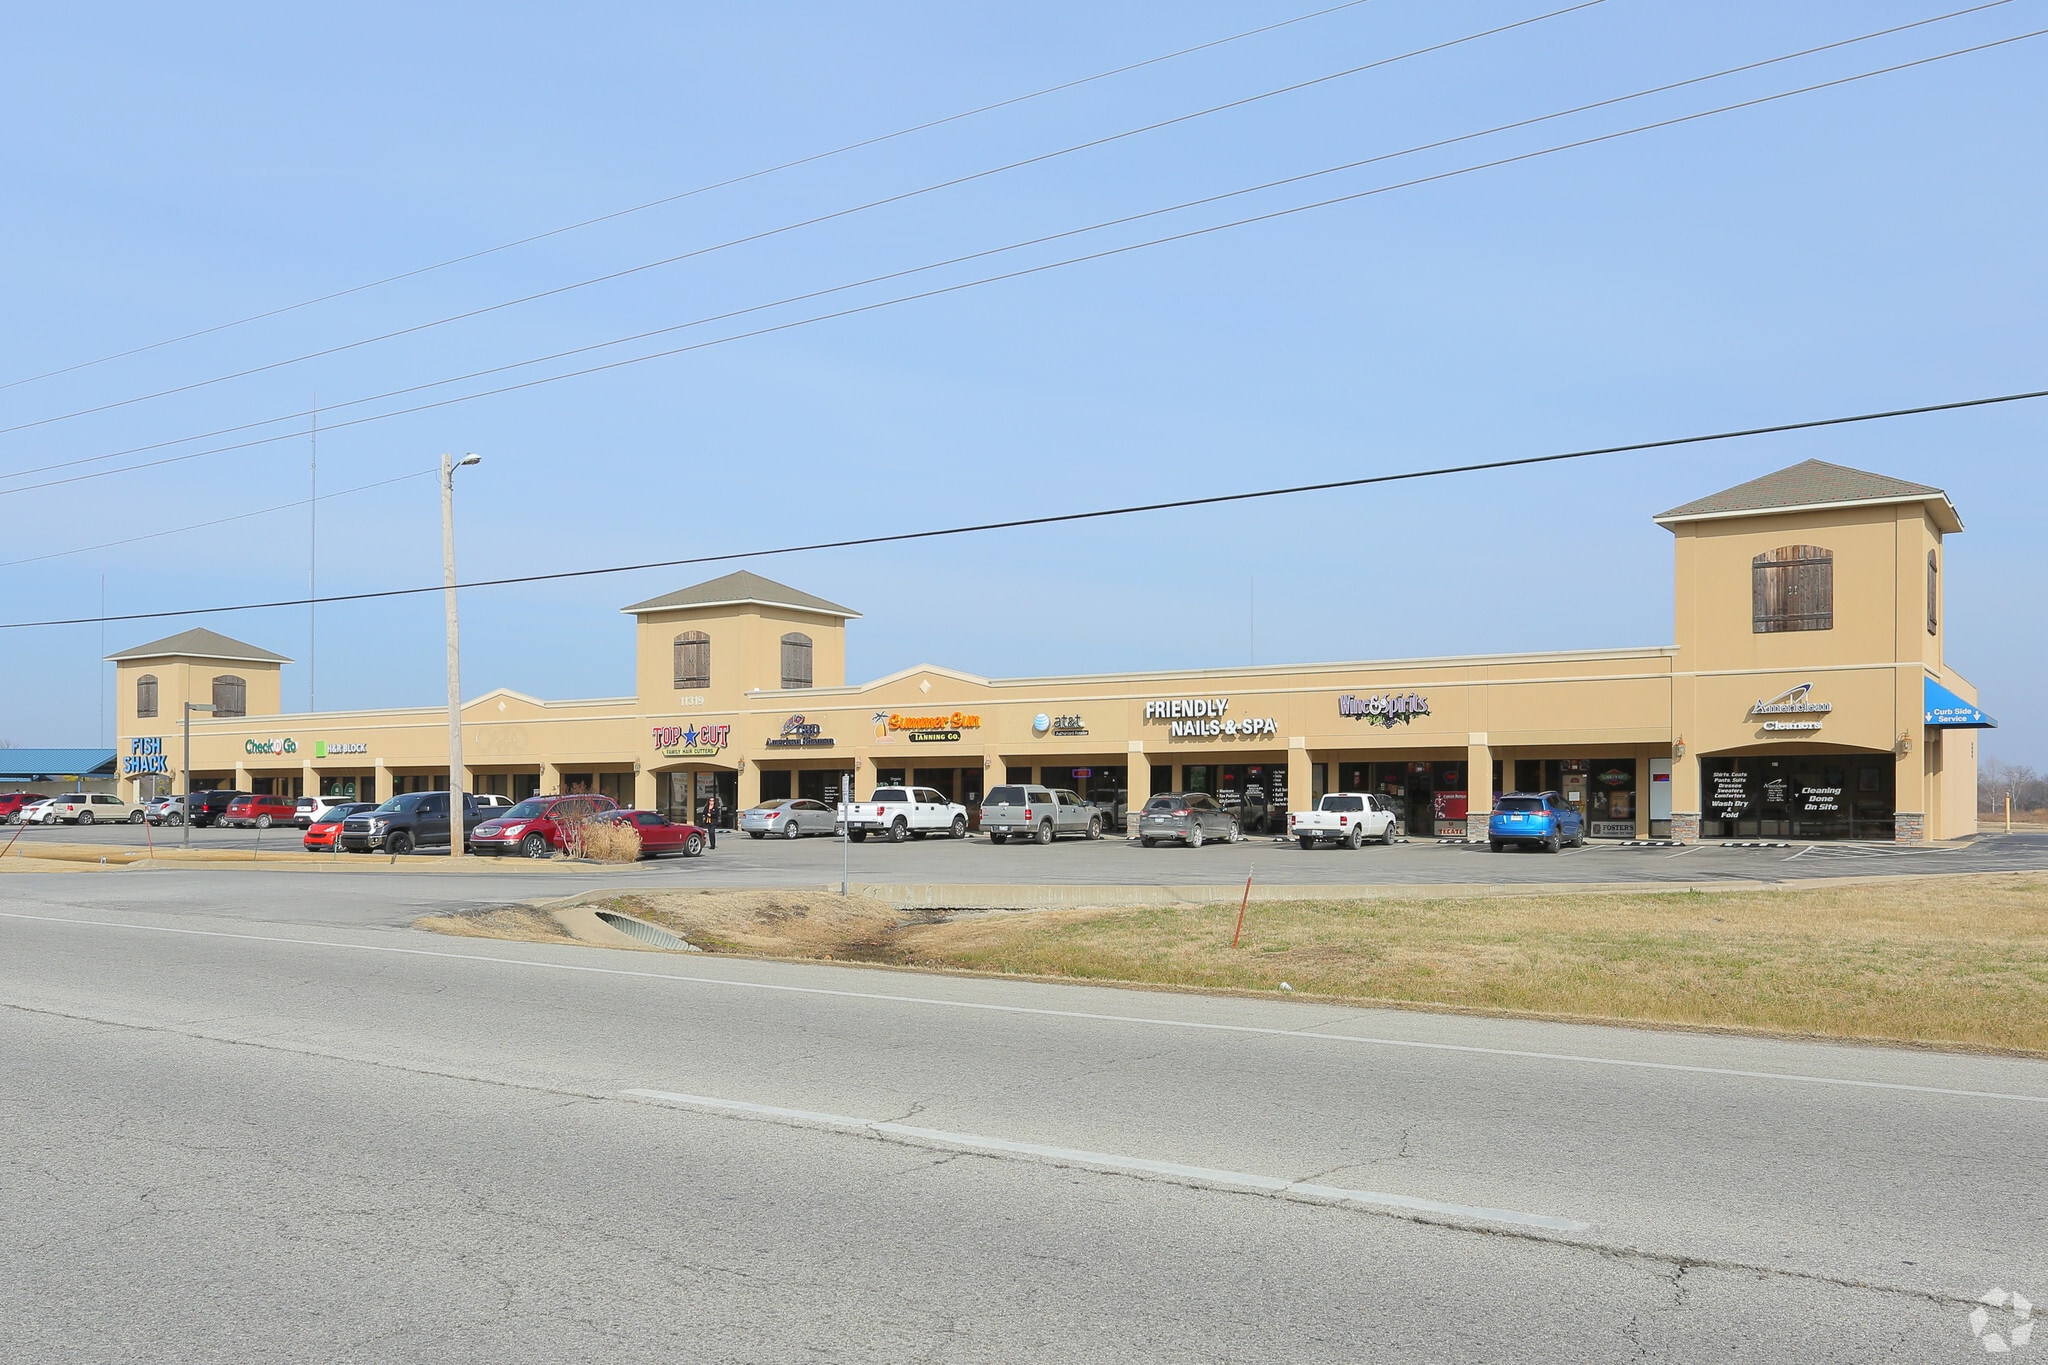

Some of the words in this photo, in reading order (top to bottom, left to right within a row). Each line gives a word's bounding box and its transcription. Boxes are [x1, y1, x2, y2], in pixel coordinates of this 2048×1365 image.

[680, 696, 704, 706] 11319
[1146, 698, 1228, 718] FRIENDLY
[888, 713, 949, 730] Summer
[950, 712, 981, 729] Sun
[1054, 714, 1081, 728] at&t
[1172, 720, 1220, 736] NAILS
[1224, 720, 1238, 735] &
[1242, 718, 1276, 734] SPA
[1763, 720, 1822, 730] Cleaners
[246, 739, 274, 754] Check
[283, 738, 298, 753] Go
[652, 726, 681, 750] TOP
[700, 725, 730, 748] CUT
[132, 738, 162, 755] FISH
[328, 744, 343, 754] H&R
[343, 743, 367, 753] BLOCK
[124, 755, 168, 773] SHACK
